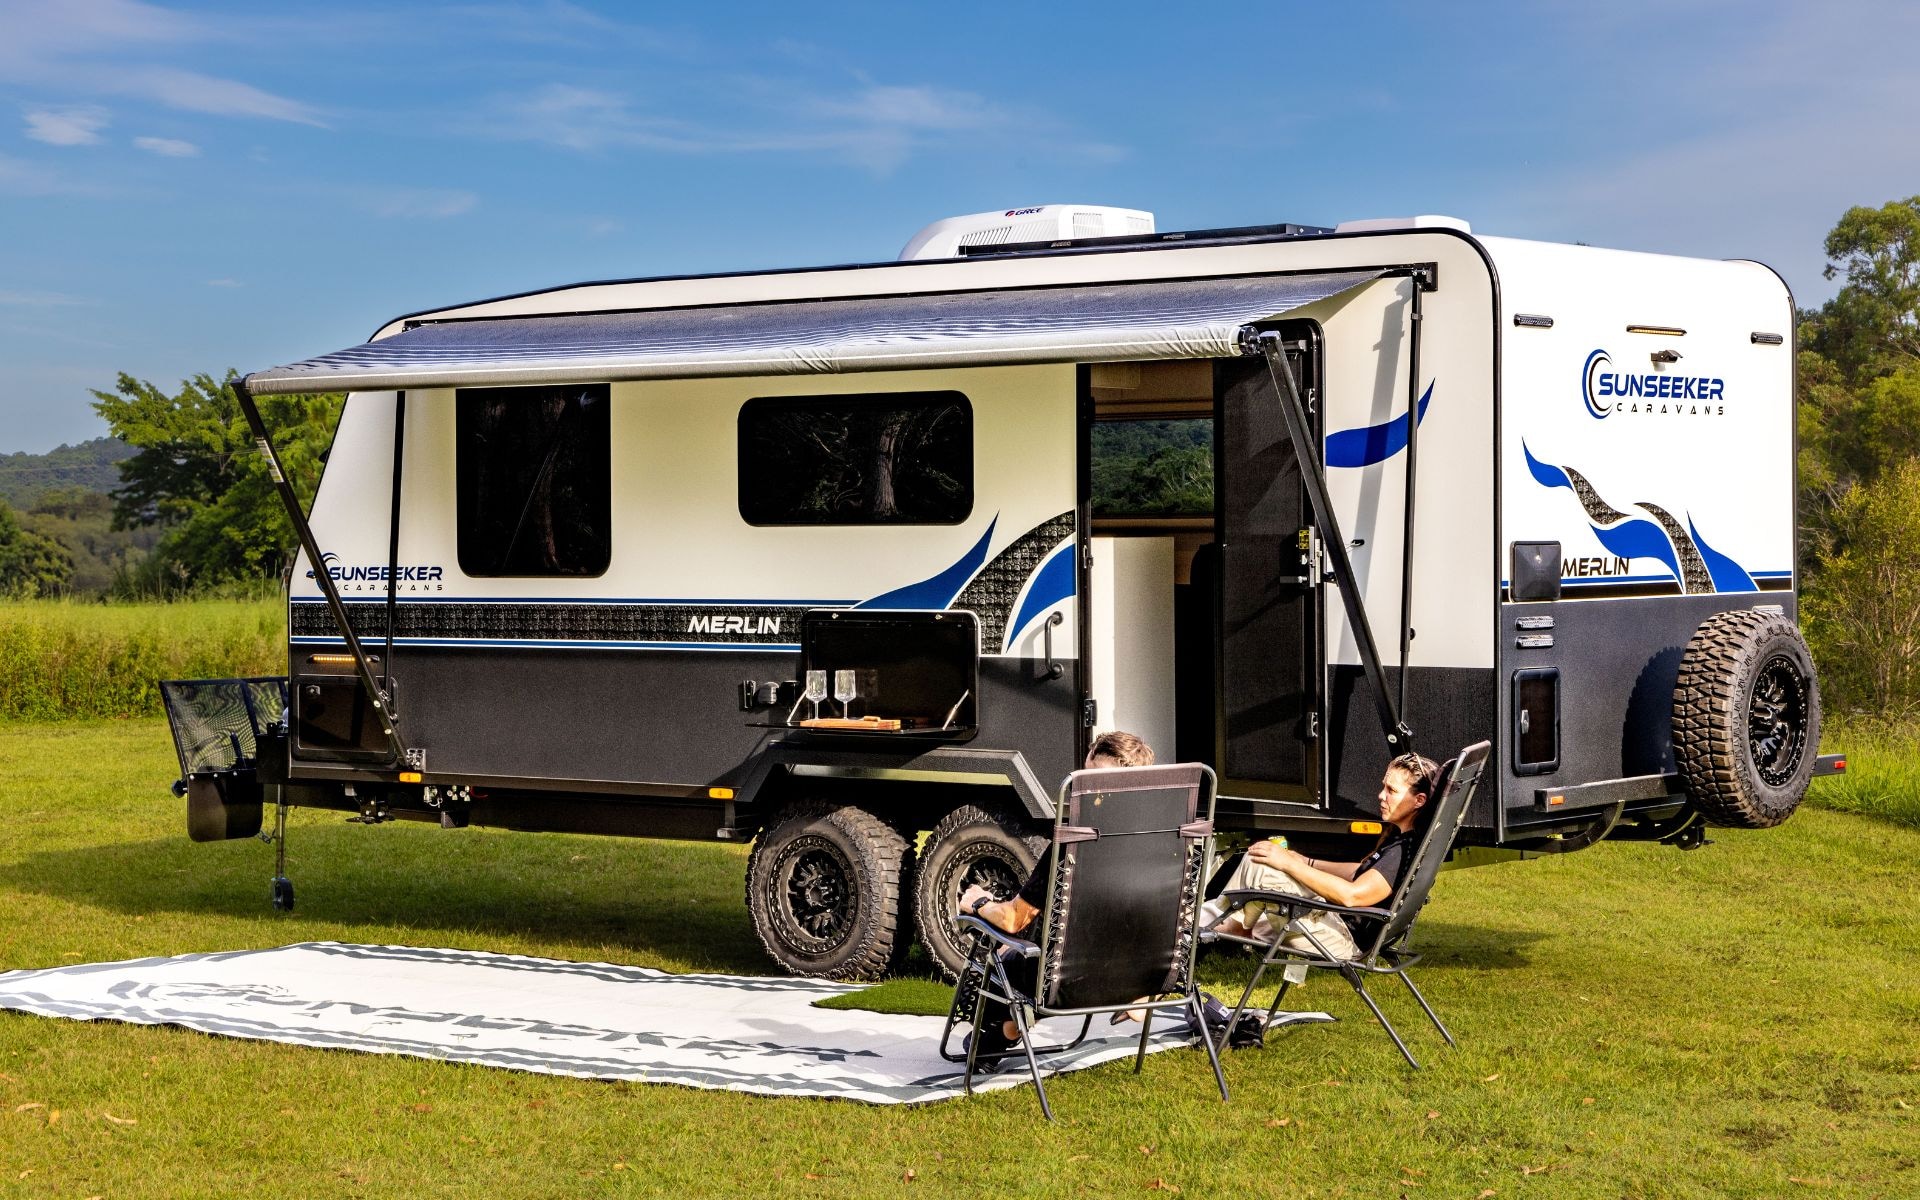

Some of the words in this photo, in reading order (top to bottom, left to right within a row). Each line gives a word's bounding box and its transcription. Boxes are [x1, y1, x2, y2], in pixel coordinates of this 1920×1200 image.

[1598, 373, 1724, 400] SUNSEEKER
[1616, 402, 1724, 416] CARAVANS
[329, 566, 443, 581] SUNSEEKER
[1560, 557, 1630, 577] MERLIN
[687, 615, 780, 635] MERLIN
